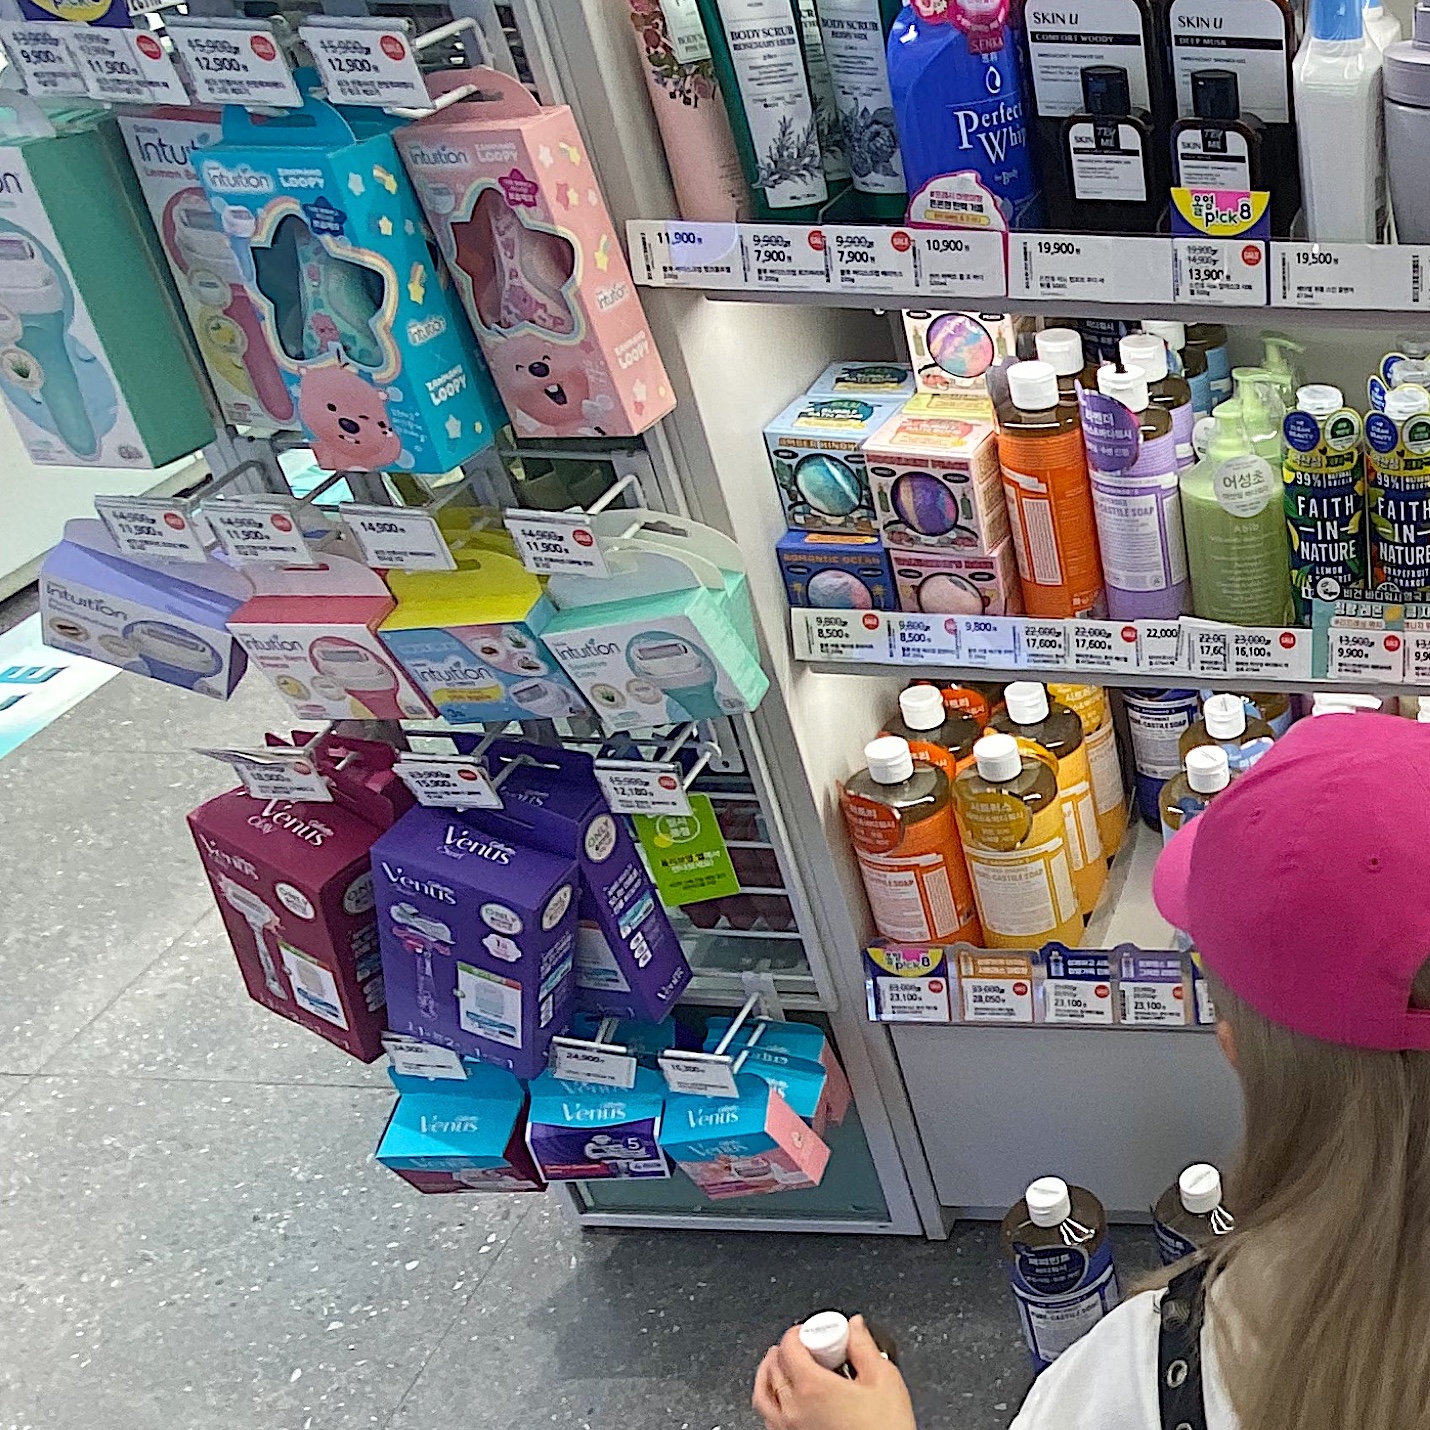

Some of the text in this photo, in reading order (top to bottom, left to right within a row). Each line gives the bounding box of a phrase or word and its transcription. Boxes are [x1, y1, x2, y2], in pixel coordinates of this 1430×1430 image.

[1032, 12, 1079, 25] SKIN U
[1178, 15, 1223, 29] SKIN U
[953, 102, 1023, 150] Perfect
[1239, 202, 1251, 220] 8
[1223, 470, 1264, 489] 어성초
[1296, 473, 1322, 487] 99%
[1376, 476, 1400, 490] 99%
[1298, 495, 1354, 518] FAITH
[1317, 521, 1339, 540] IN
[1395, 524, 1415, 544] IN
[1301, 540, 1357, 563] NATURE
[47, 581, 128, 621] Intuition
[556, 638, 621, 661] Intuition
[415, 661, 492, 682] Intuition
[262, 798, 324, 847] Venus
[445, 824, 512, 866] Venus
[382, 861, 457, 905] Venus
[562, 1101, 627, 1122] Venus
[686, 1107, 740, 1129] Venus
[419, 1113, 478, 1135] Venus
[627, 1137, 640, 1150] 5
